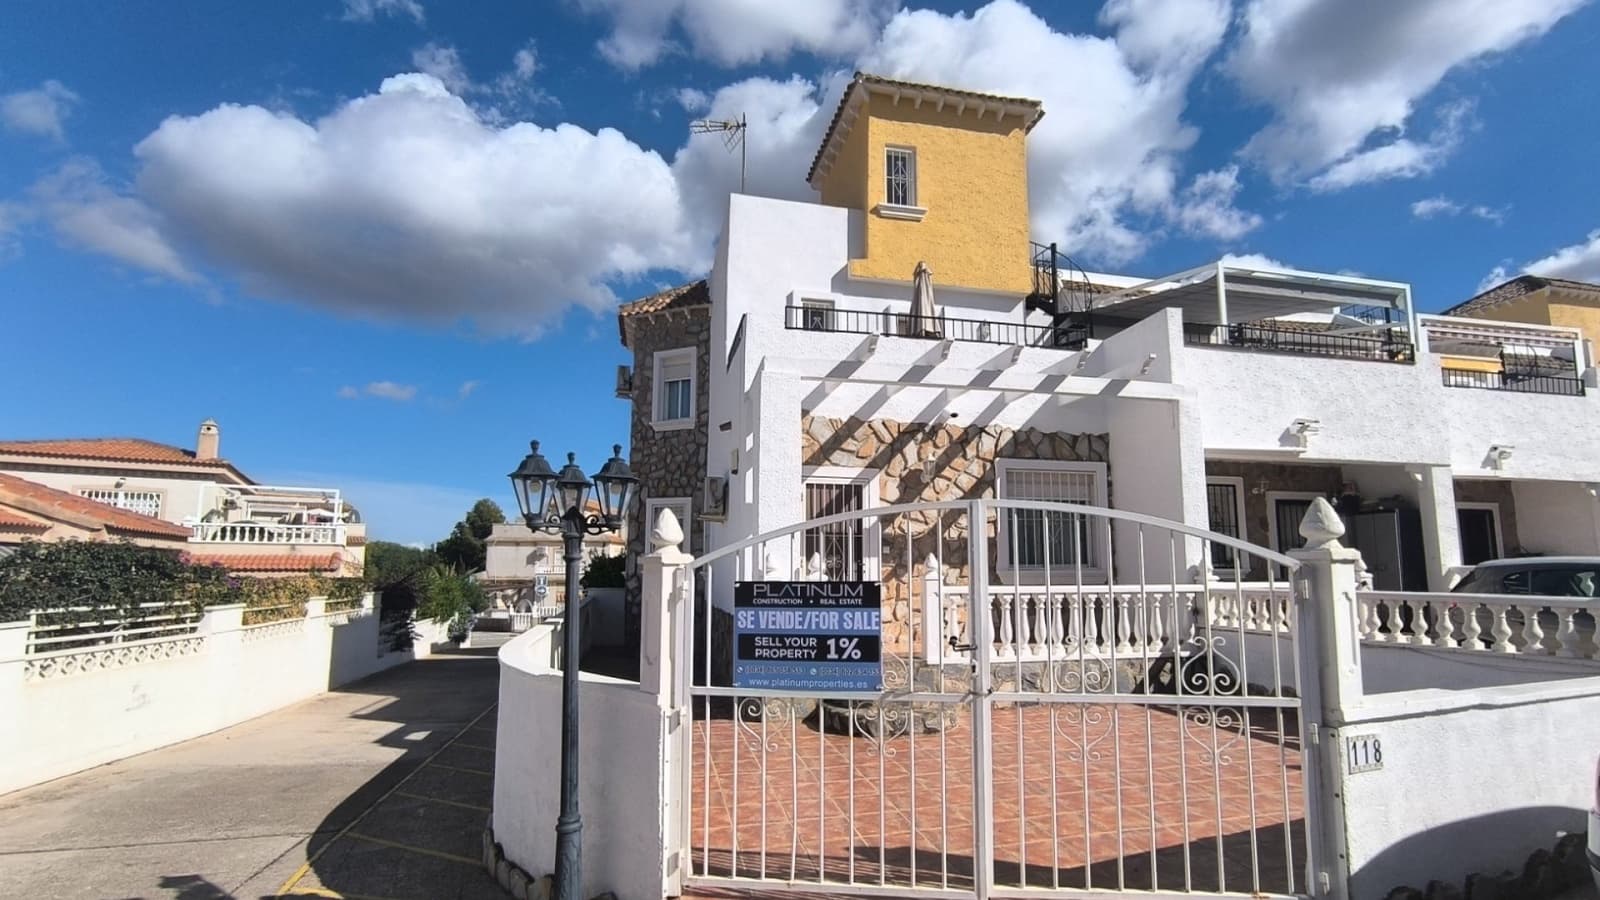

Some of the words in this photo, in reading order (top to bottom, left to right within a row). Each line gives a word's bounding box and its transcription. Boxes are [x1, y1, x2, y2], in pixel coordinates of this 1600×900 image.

[753, 583, 863, 597] PLATINUM
[737, 610, 755, 629] SE
[759, 610, 839, 630] VENDE/FOR
[843, 611, 880, 630] SALE
[754, 637, 783, 647] SELL
[784, 637, 817, 647] YOUR
[826, 638, 861, 659] 1%
[755, 648, 817, 658] PROPERTY
[749, 678, 868, 689] www.platinumproperties.es
[1352, 739, 1382, 765] 118
